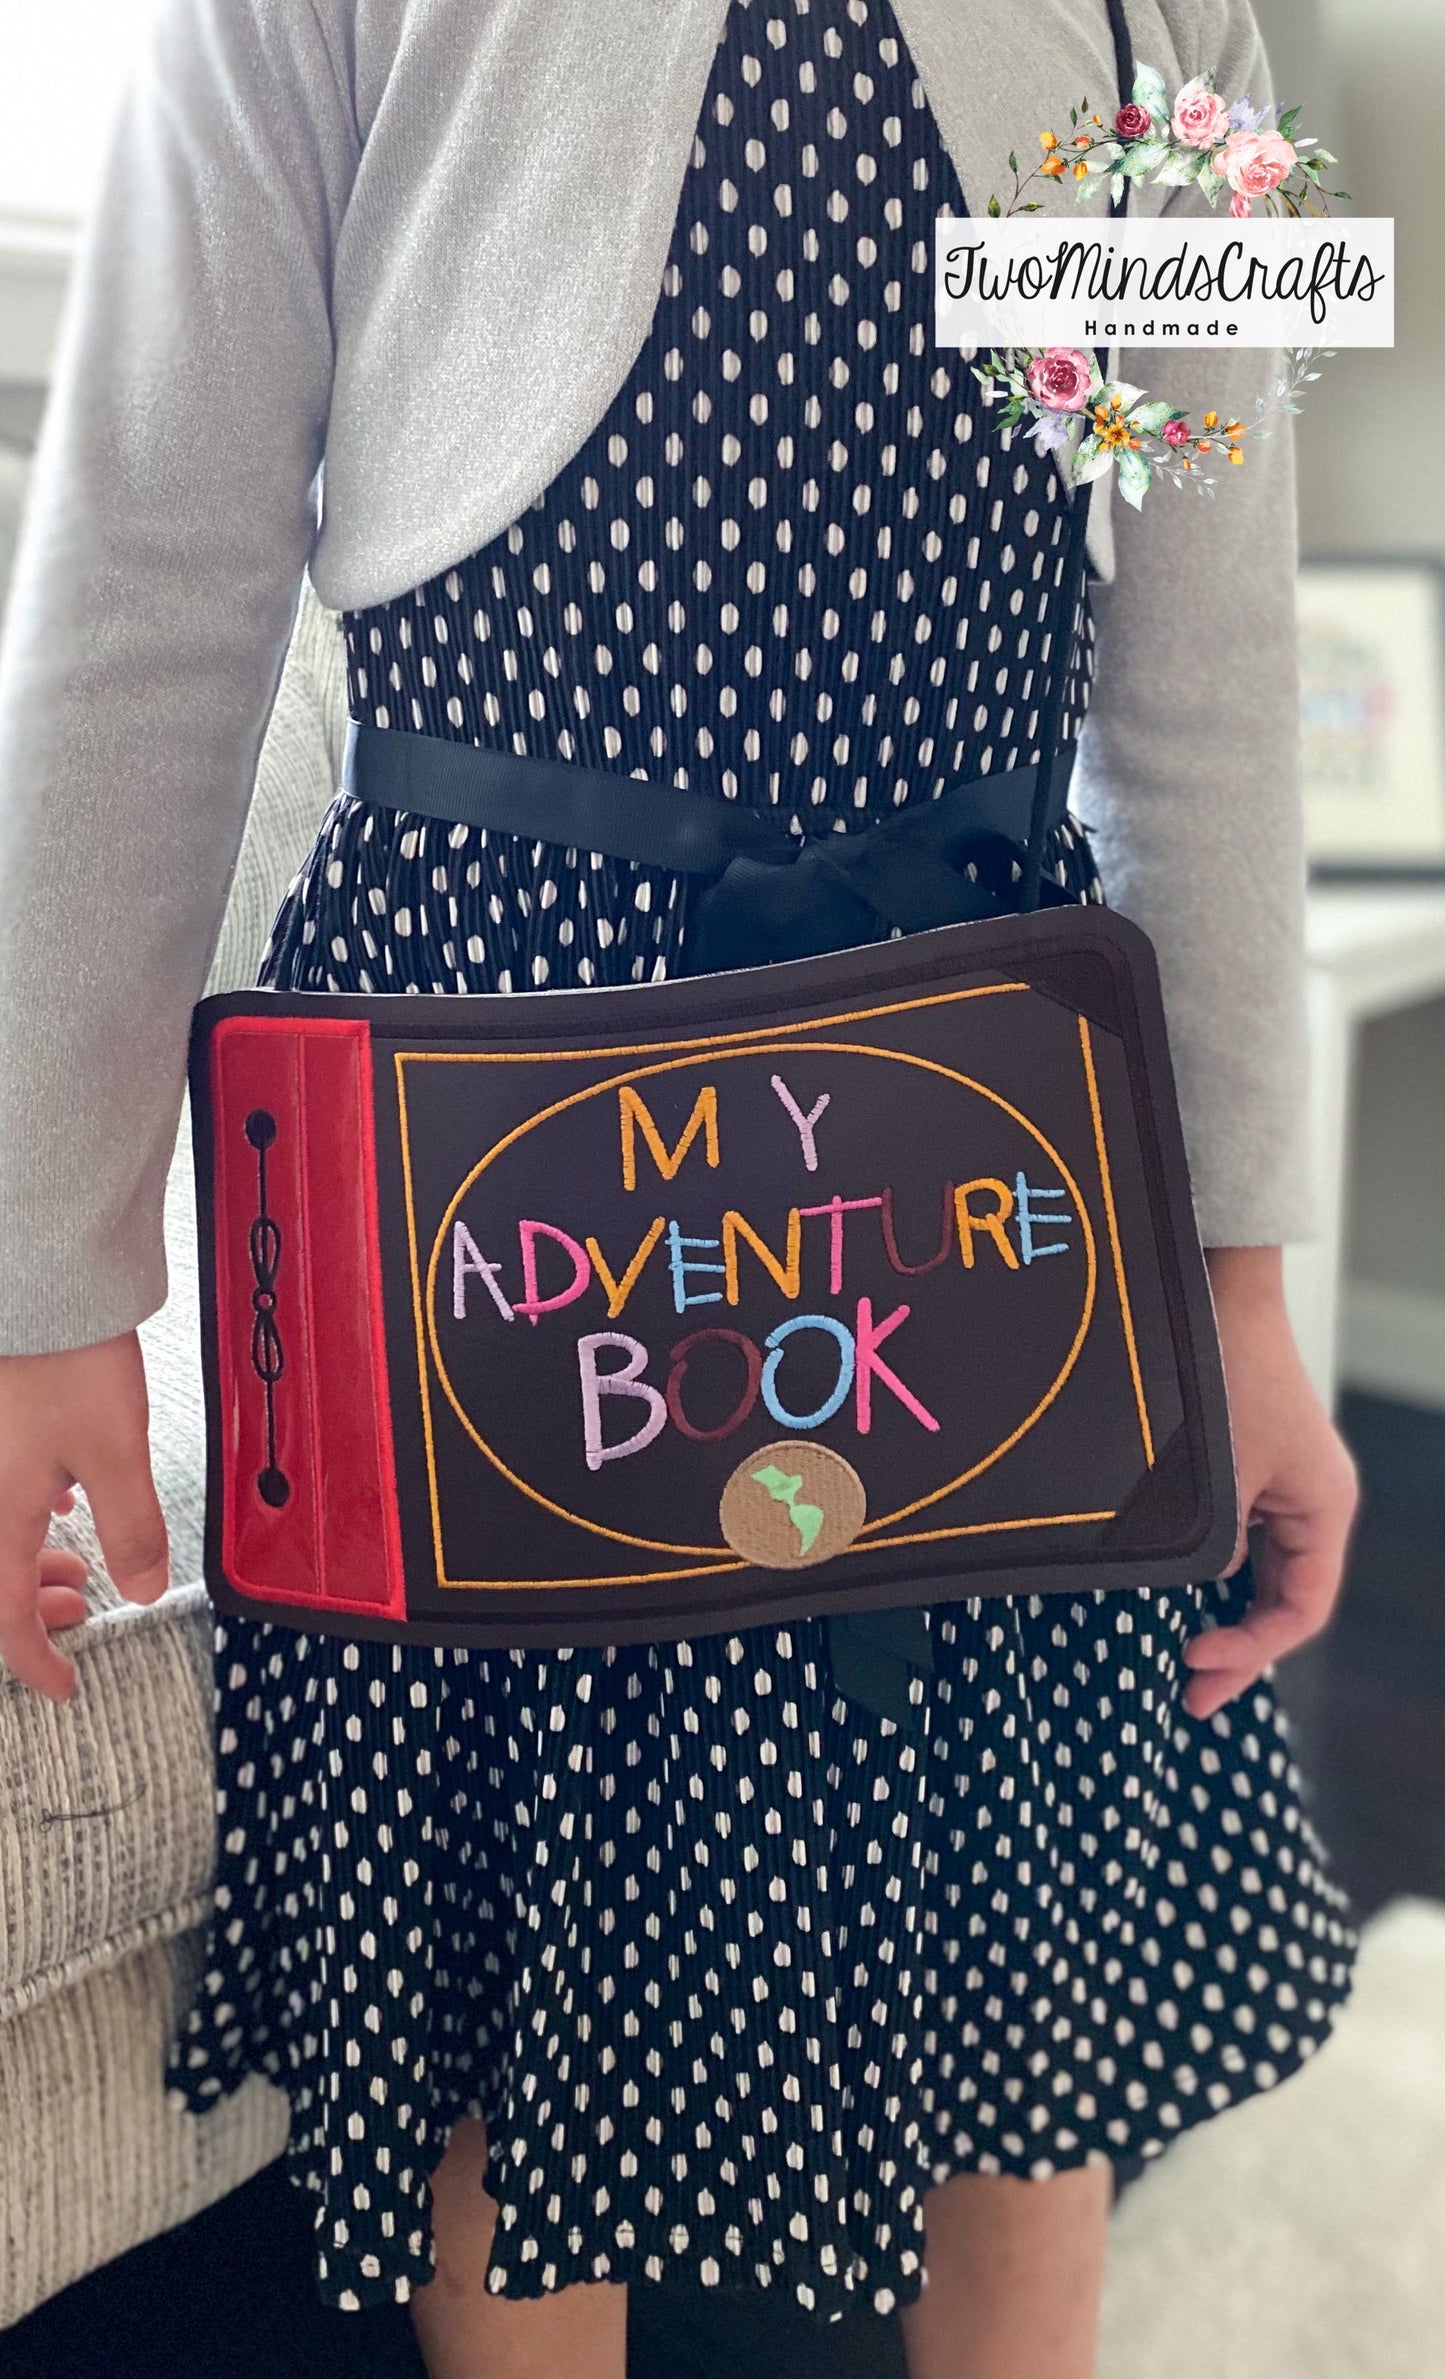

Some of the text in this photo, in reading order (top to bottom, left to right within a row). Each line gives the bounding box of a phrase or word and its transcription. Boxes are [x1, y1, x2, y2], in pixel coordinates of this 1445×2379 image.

[618, 1074, 831, 1191] MY
[453, 1171, 1072, 1326] ADVENTURE
[577, 1297, 940, 1471] BOOK
